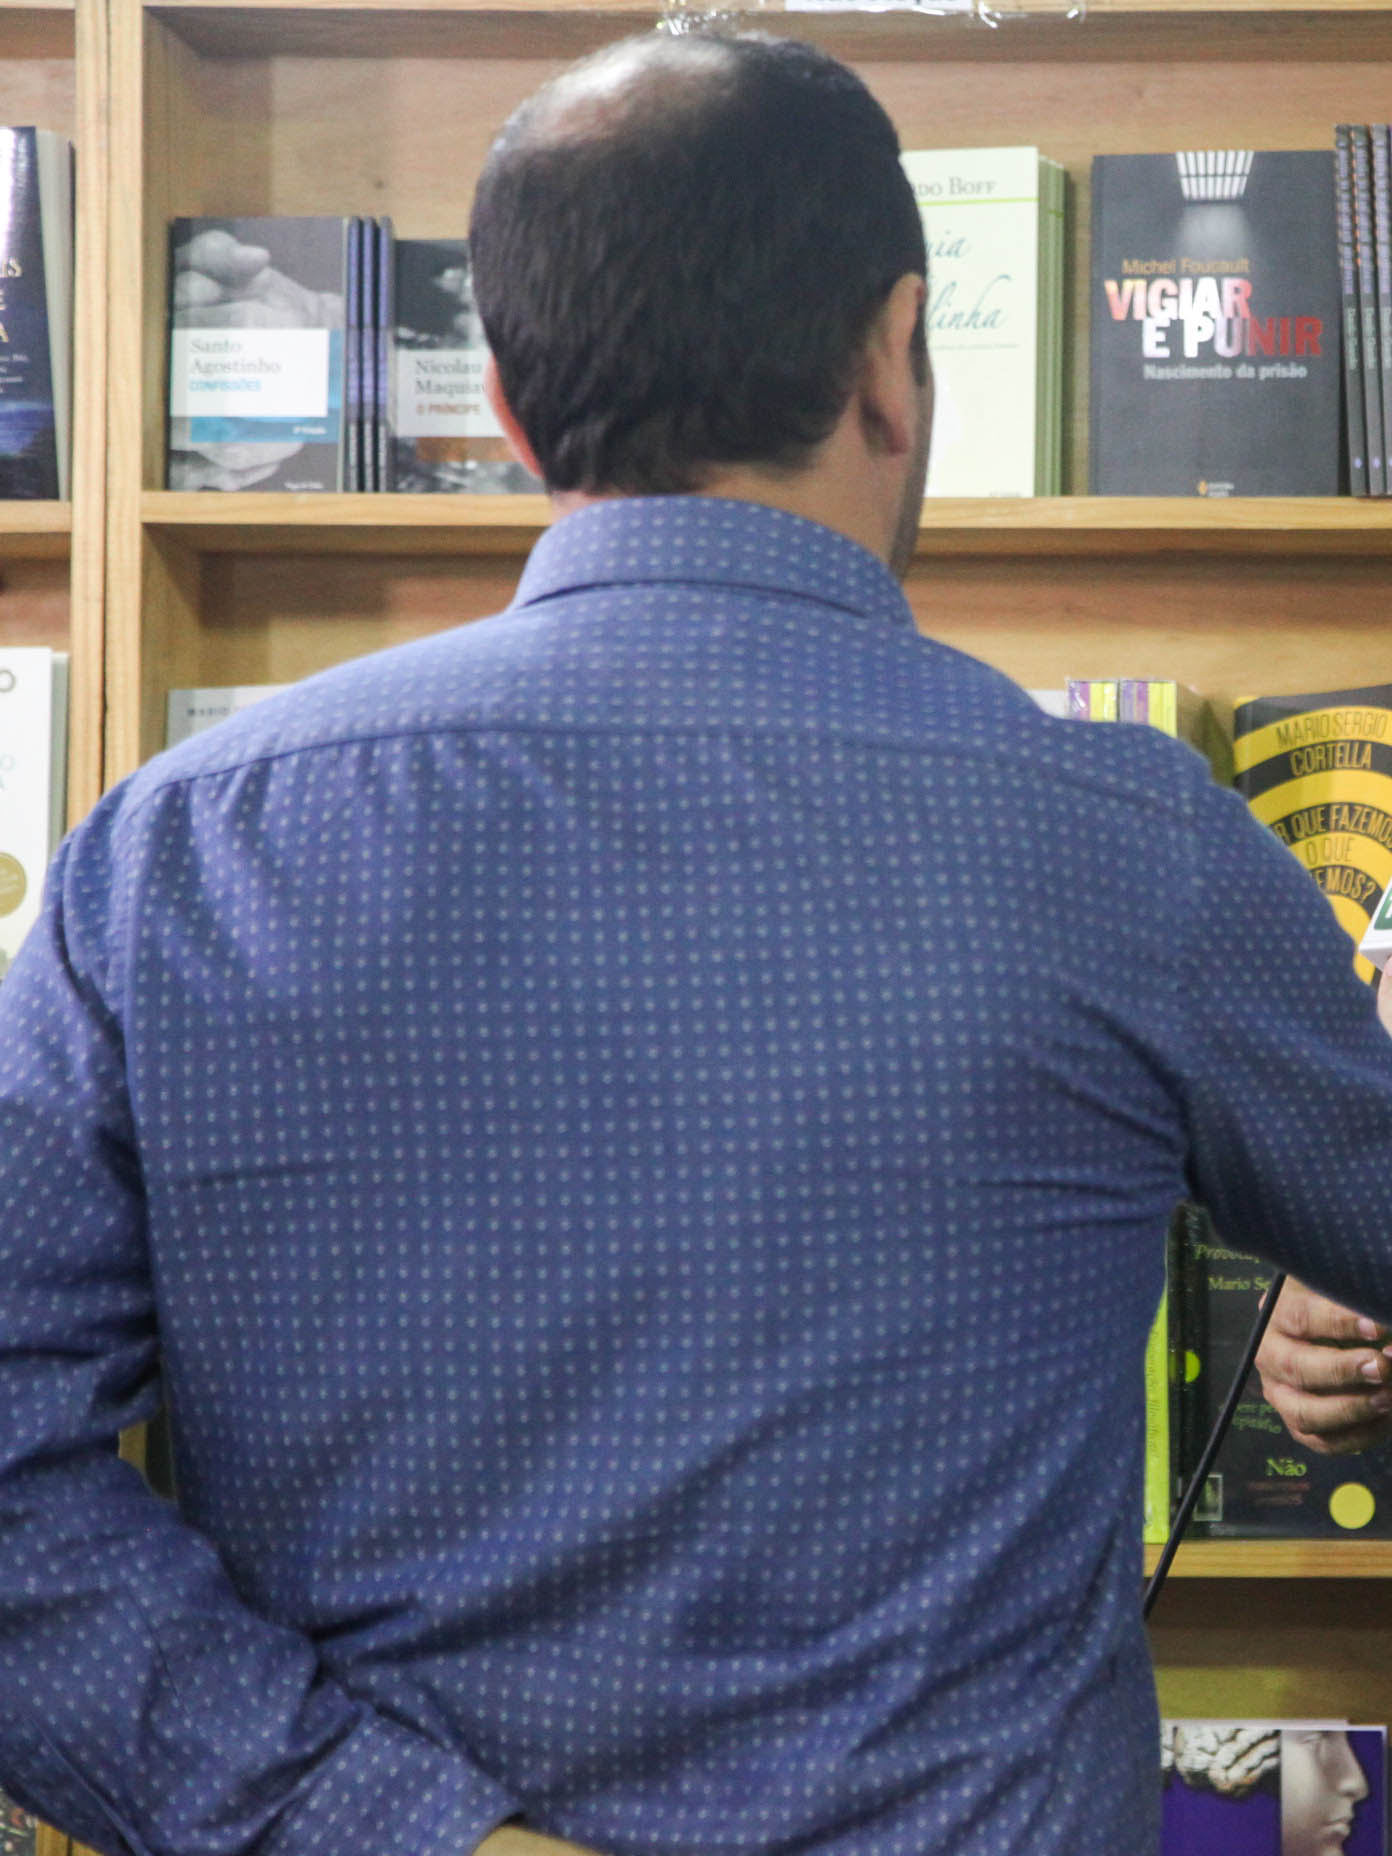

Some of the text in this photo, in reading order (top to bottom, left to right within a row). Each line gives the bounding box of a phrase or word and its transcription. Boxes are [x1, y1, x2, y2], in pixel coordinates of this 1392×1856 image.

[1122, 258, 1251, 275] Michel Foucault
[1104, 277, 1253, 321] VIGIAR
[1142, 317, 1170, 358] E
[1183, 315, 1323, 358] PUNIR
[1143, 362, 1308, 381] Nascimento da prisão
[1276, 714, 1330, 748] MARIO
[1290, 742, 1373, 777] CORTELLA
[1291, 807, 1327, 839] QUE
[1314, 866, 1377, 904] EMOS?
[1265, 1458, 1307, 1477] Não
